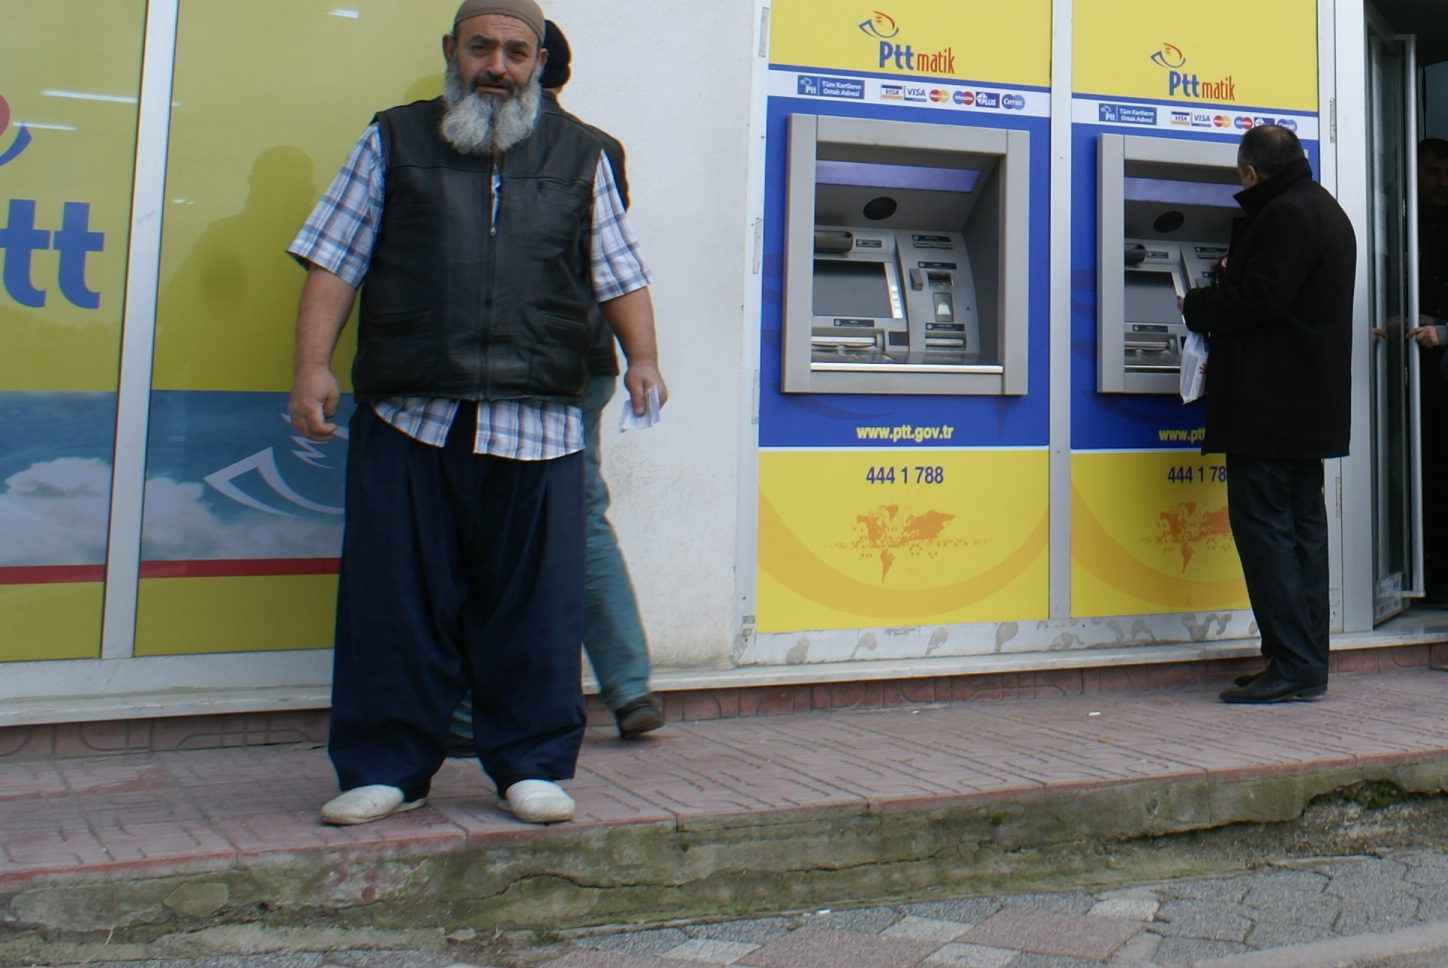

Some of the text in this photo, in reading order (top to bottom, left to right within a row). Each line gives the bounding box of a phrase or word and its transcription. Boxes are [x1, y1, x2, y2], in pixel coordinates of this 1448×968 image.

[907, 87, 926, 96] VISA
[1194, 114, 1210, 122] VISA
[0, 198, 105, 309] tt
[856, 424, 954, 443] www.ptt.gov.tr
[866, 465, 944, 484] 444 1 788
[1167, 465, 1227, 483] 444 1 78
